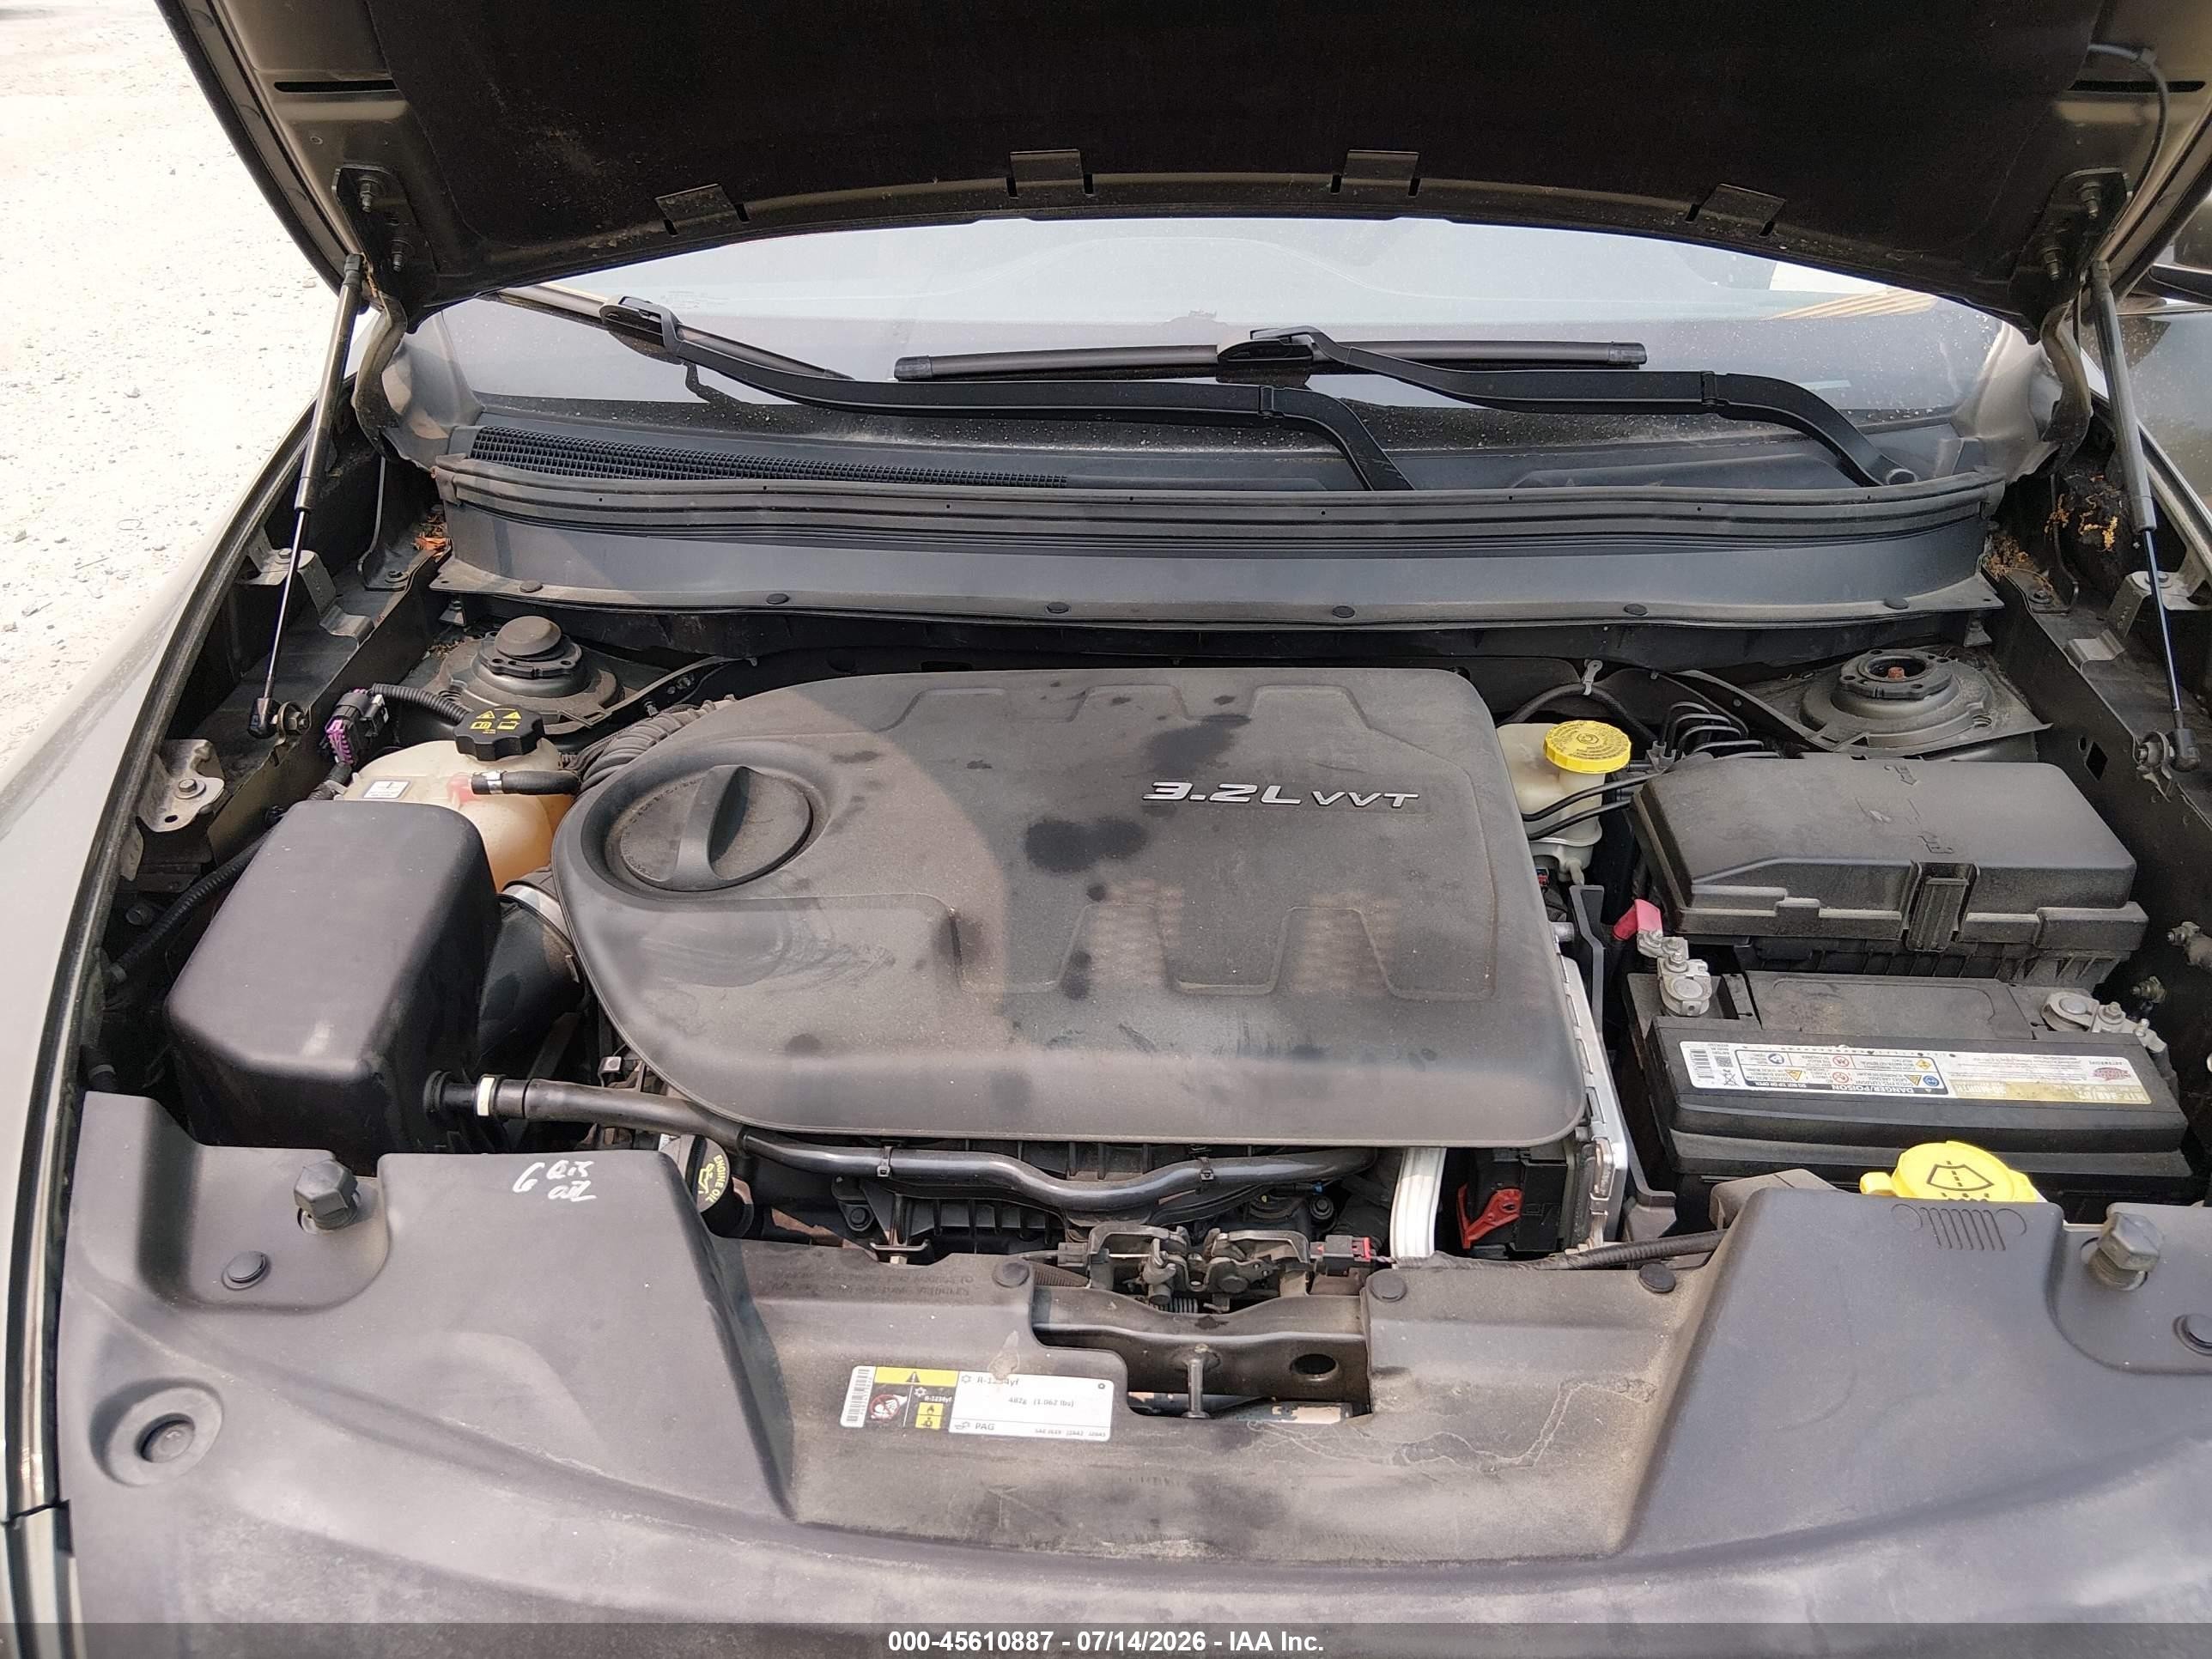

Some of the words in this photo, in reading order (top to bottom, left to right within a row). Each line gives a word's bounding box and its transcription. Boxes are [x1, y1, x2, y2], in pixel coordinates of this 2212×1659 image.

[1142, 781, 1302, 805] 3.2L
[1310, 790, 1419, 808] VVT
[1832, 1084, 1914, 1094] DANGER/POISON
[713, 1154, 726, 1189] ENGINE
[705, 1188, 721, 1203] OIL
[975, 1422, 995, 1431] PAG
